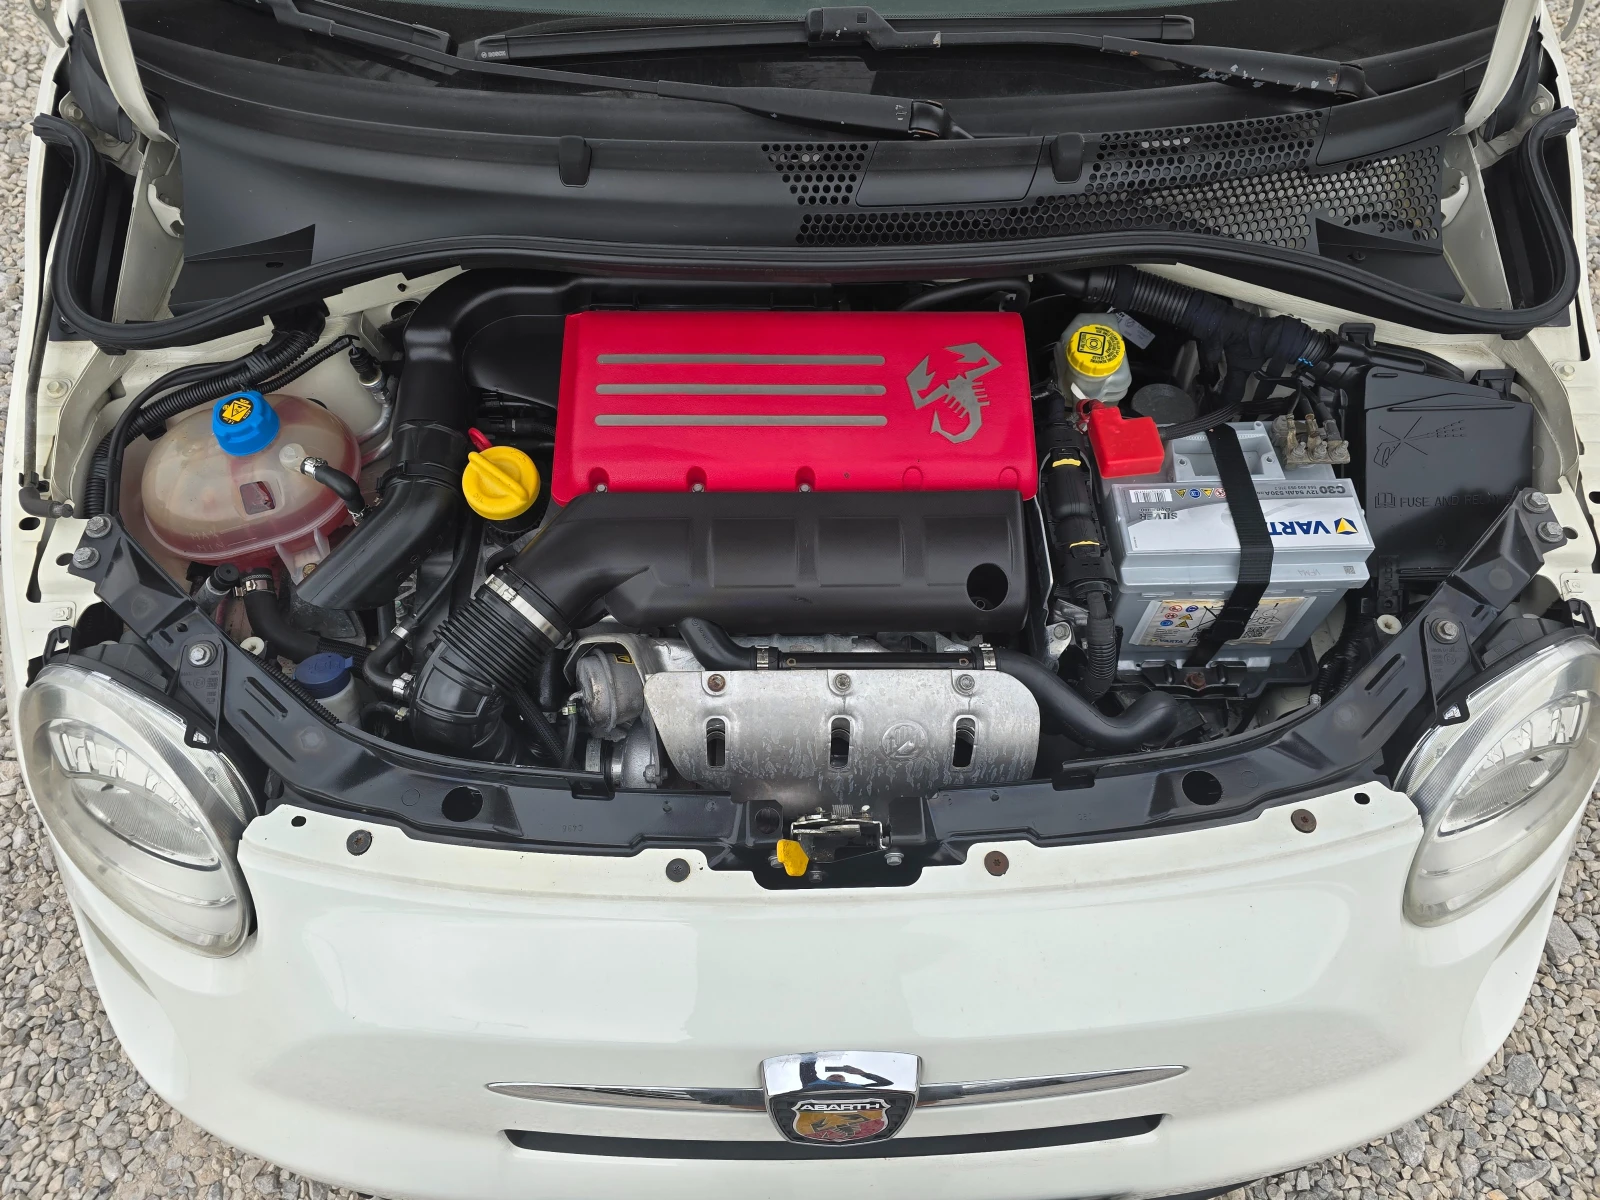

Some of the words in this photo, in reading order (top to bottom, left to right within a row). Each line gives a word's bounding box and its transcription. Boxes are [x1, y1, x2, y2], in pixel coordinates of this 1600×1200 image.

[1319, 485, 1346, 494] C30
[1400, 496, 1430, 508] FUSE
[1434, 495, 1459, 507] AND
[1140, 512, 1178, 520] SILVER
[1268, 520, 1332, 536] VART
[800, 1103, 880, 1111] ABARTH
